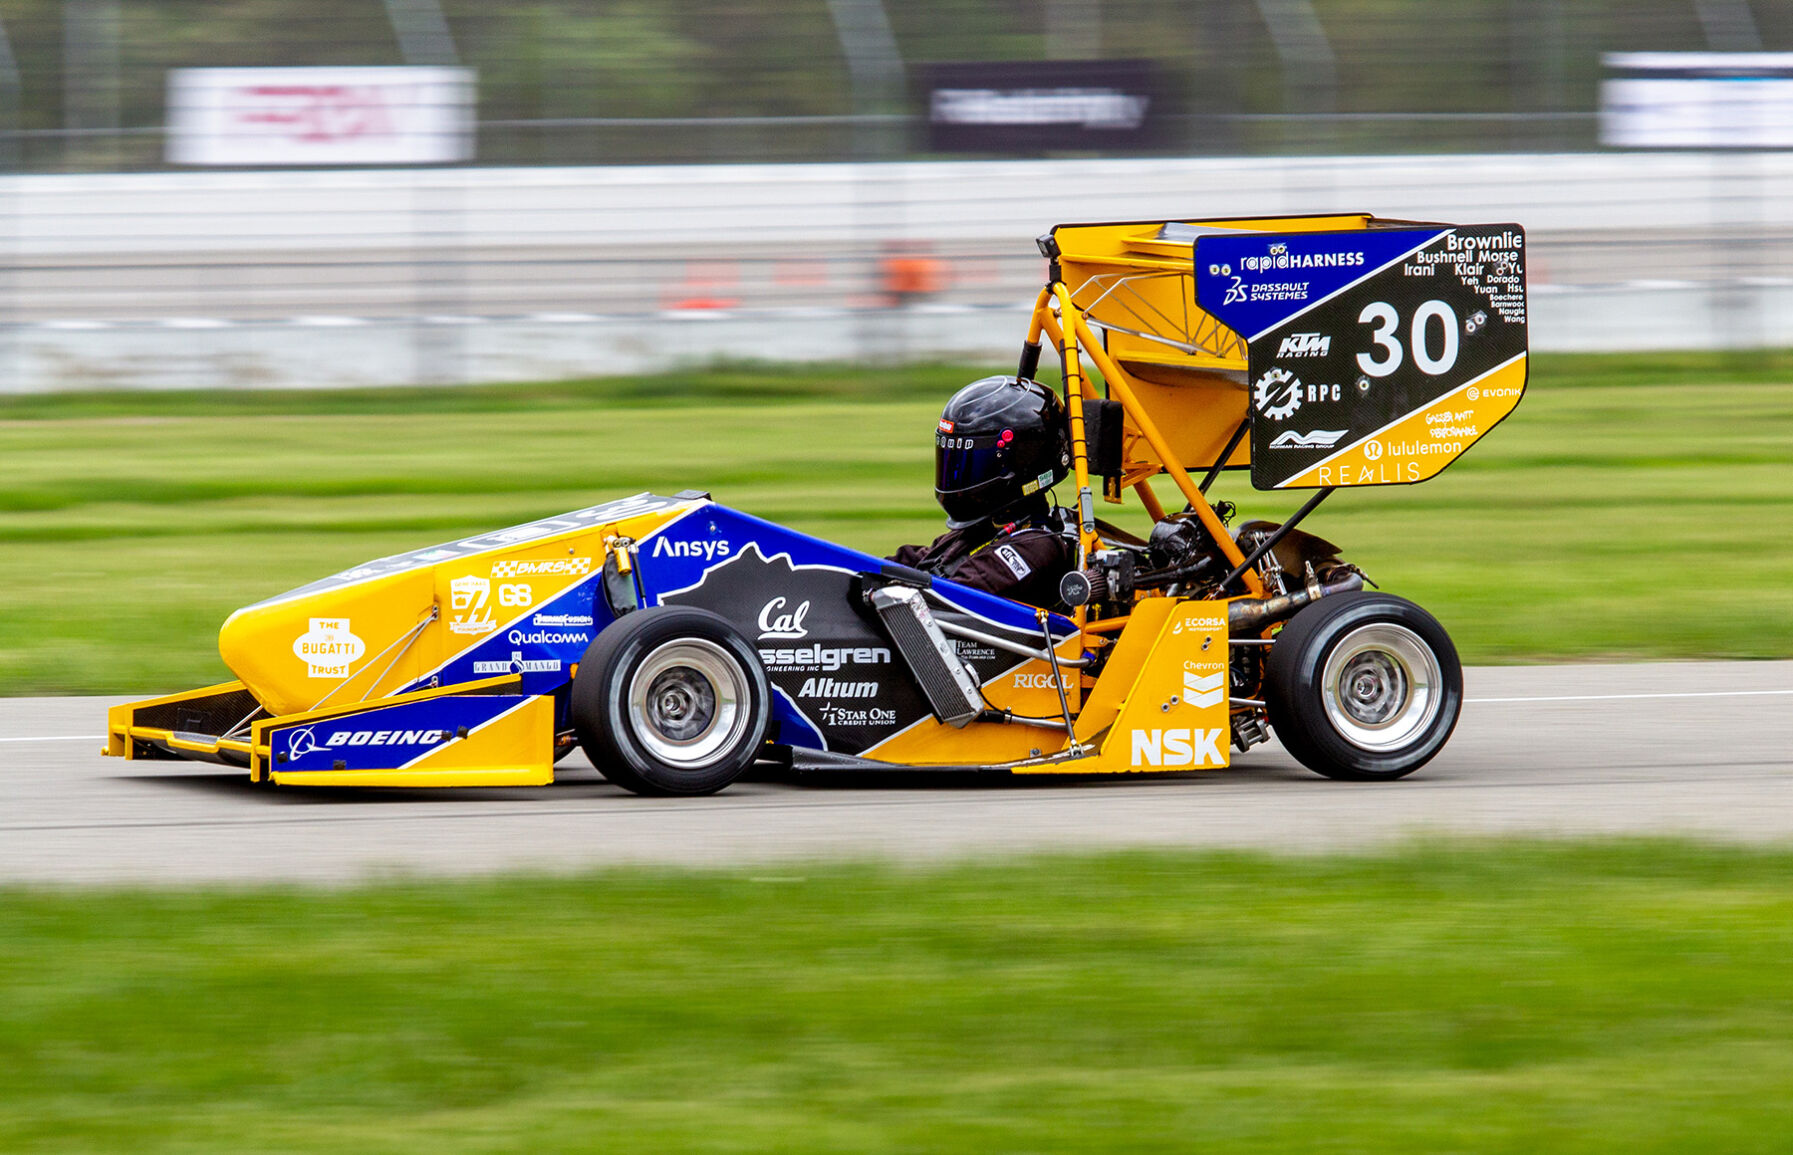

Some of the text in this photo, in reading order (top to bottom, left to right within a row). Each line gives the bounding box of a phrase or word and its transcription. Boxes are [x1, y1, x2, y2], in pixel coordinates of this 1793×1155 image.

[1447, 231, 1522, 250] Brownlie
[1417, 250, 1519, 264] Bushnell Morse
[1404, 262, 1435, 276] Irani
[1454, 262, 1485, 276] Klair
[1250, 282, 1310, 292] DASSAULT
[1461, 274, 1520, 286] Yeh Dorado
[1250, 291, 1308, 301] SYSTEMES
[1474, 285, 1498, 294] Yuan
[1279, 332, 1331, 353] KTM
[1356, 299, 1459, 378] 30
[1276, 351, 1329, 359] RACING
[1307, 384, 1341, 402] RPC
[1387, 441, 1462, 456] lululemon
[652, 536, 730, 560] Ansys
[516, 561, 566, 574] BMRS
[758, 596, 811, 639] Cal
[1184, 617, 1226, 627] ECORSA
[319, 621, 339, 630] THE
[508, 629, 589, 645] Qualcomm
[302, 642, 355, 655] BUGATTI
[956, 640, 978, 649] TEAM
[956, 646, 995, 656] LAWRENCE
[758, 643, 891, 671] sselgren
[311, 664, 346, 674] TRUST
[1183, 660, 1225, 670] Chevron
[798, 677, 879, 698] Altium
[1013, 673, 1074, 689] RIGOL
[837, 708, 868, 720] STAR
[869, 707, 896, 720] ONE
[325, 730, 444, 747] BOEING
[1131, 727, 1226, 767] NSK
